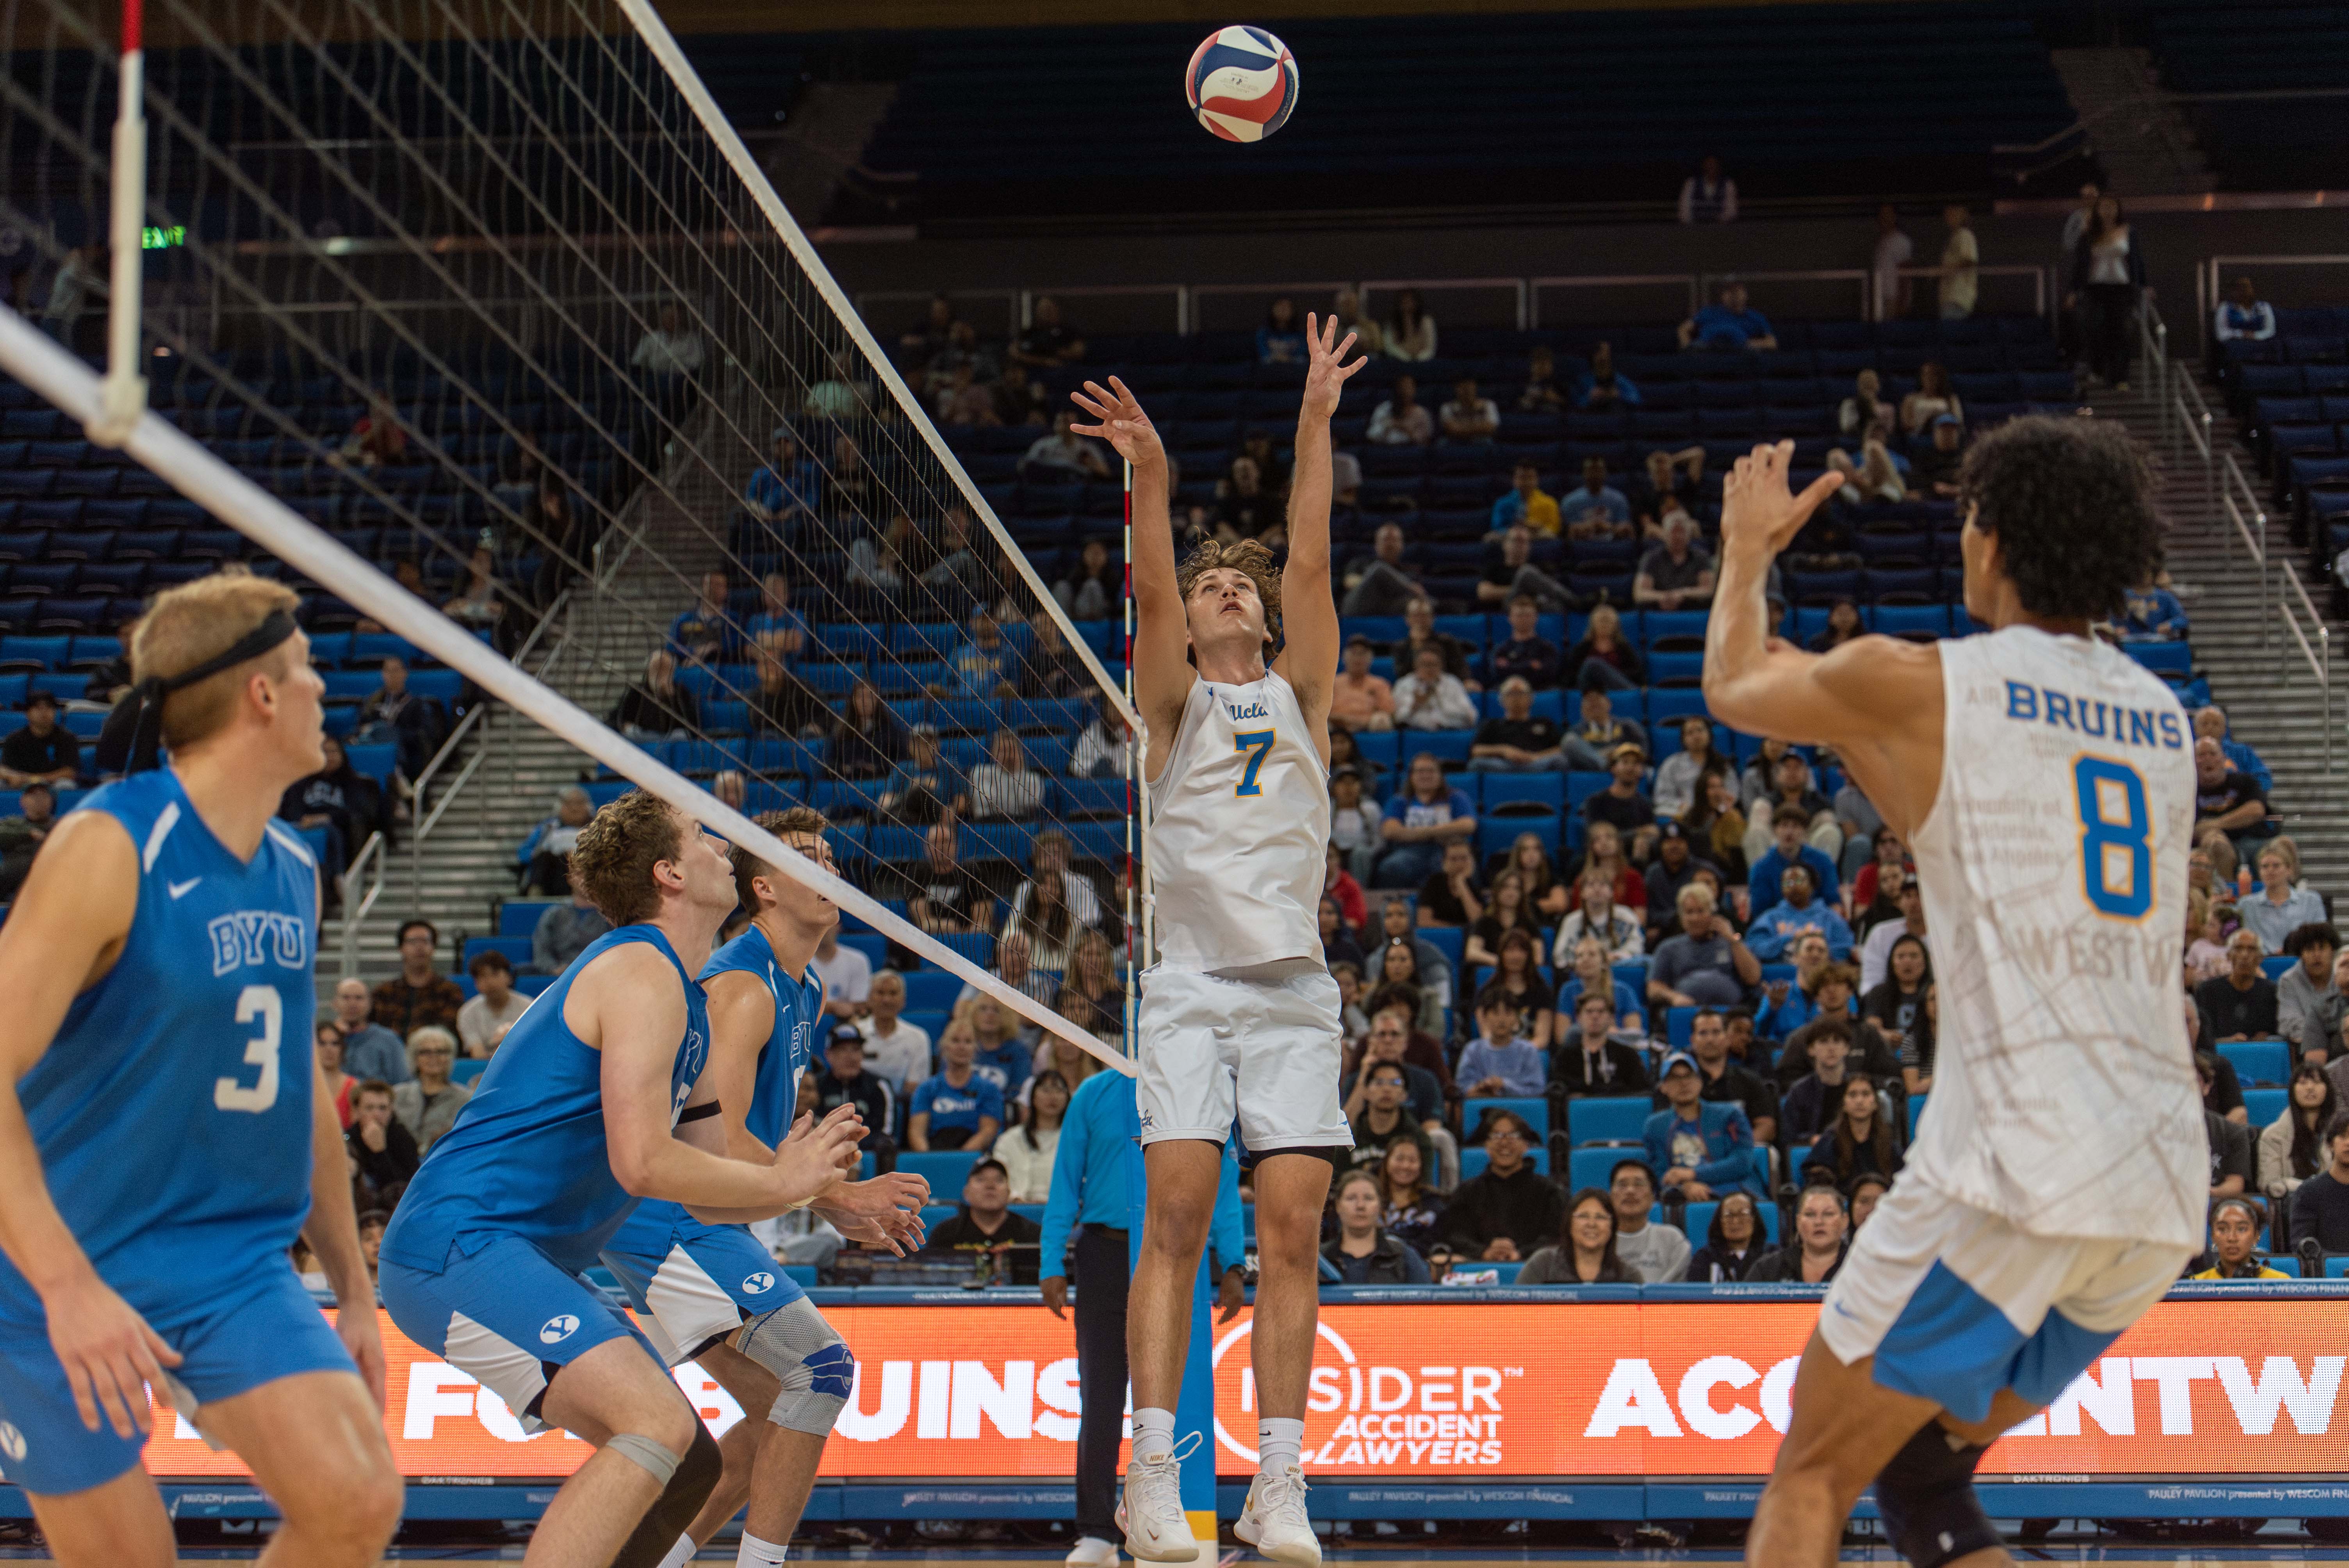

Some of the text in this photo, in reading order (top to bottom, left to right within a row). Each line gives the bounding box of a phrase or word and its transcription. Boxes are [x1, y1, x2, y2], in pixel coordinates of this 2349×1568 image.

[1281, 78, 1294, 116] molten
[142, 225, 186, 249] EXIT
[2005, 678, 2183, 750] BRUINS
[1233, 727, 1277, 799] 7
[2070, 750, 2158, 926] 8
[207, 910, 307, 977] BYU
[214, 985, 283, 1114] 3
[672, 1358, 1082, 1441] BUINS
[1241, 1366, 1502, 1413] ISIDER
[1332, 1414, 1503, 1439] ACCIDENT
[1287, 1466, 1301, 1474] NIKE
[1312, 1440, 1502, 1465] LAWYERS
[2012, 1474, 2090, 1483] DAKTRONICS
[2148, 1489, 2182, 1499] PAULEY
[2184, 1489, 2226, 1499] PAVILION
[2228, 1489, 2271, 1501] presented
[2273, 1489, 2287, 1501] by
[2287, 1488, 2330, 1499] WESCOM
